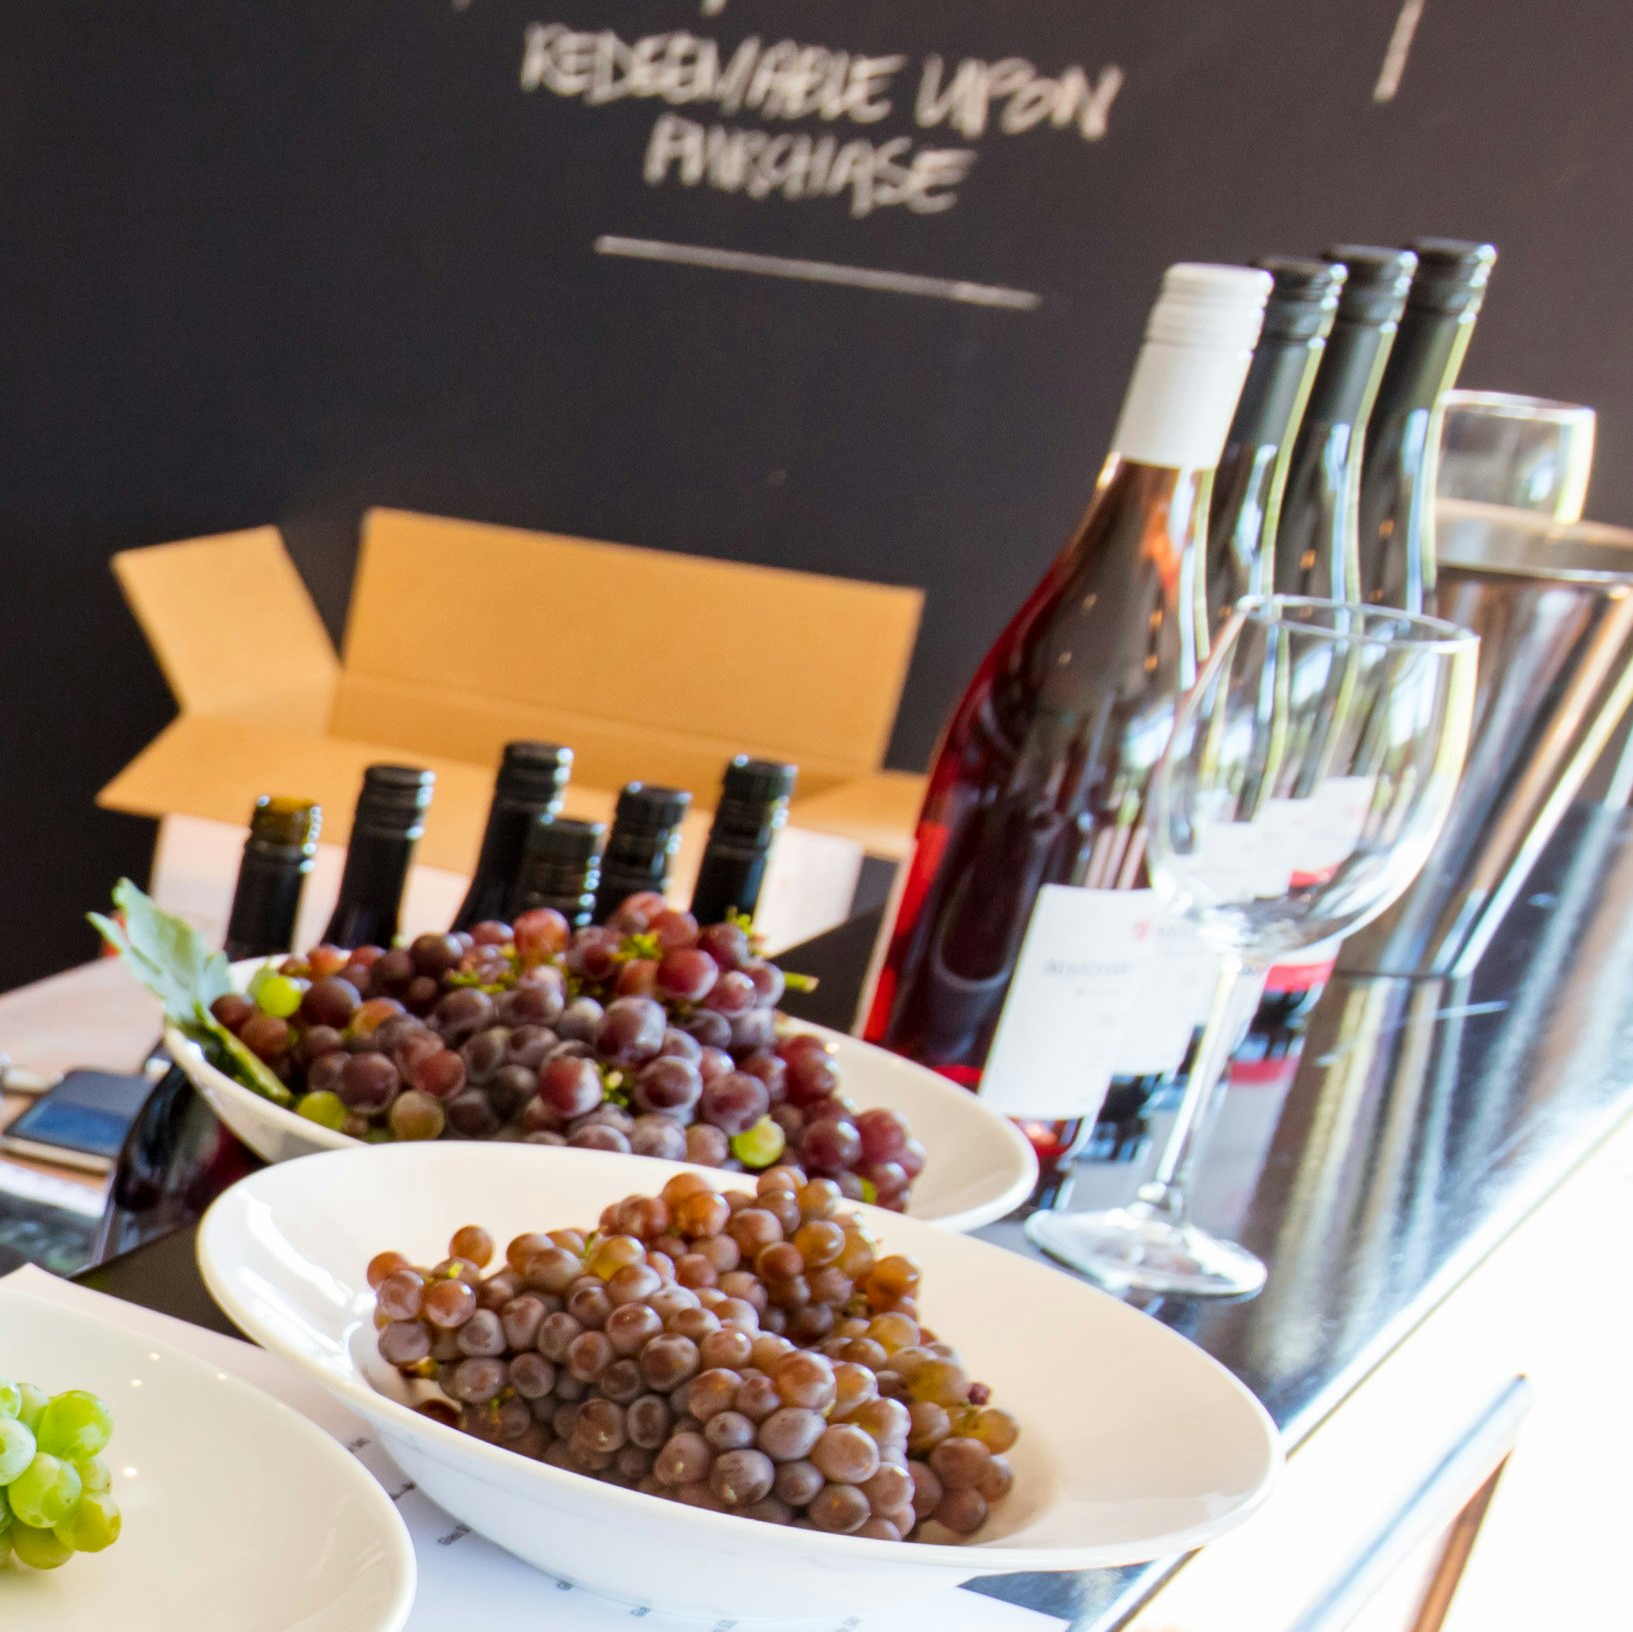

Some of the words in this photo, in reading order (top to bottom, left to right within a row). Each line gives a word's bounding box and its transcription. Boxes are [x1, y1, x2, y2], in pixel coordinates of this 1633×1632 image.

[520, 21, 907, 124] REDEEMABLE
[914, 52, 1125, 141] UPON
[642, 110, 979, 220] PURCHASE
